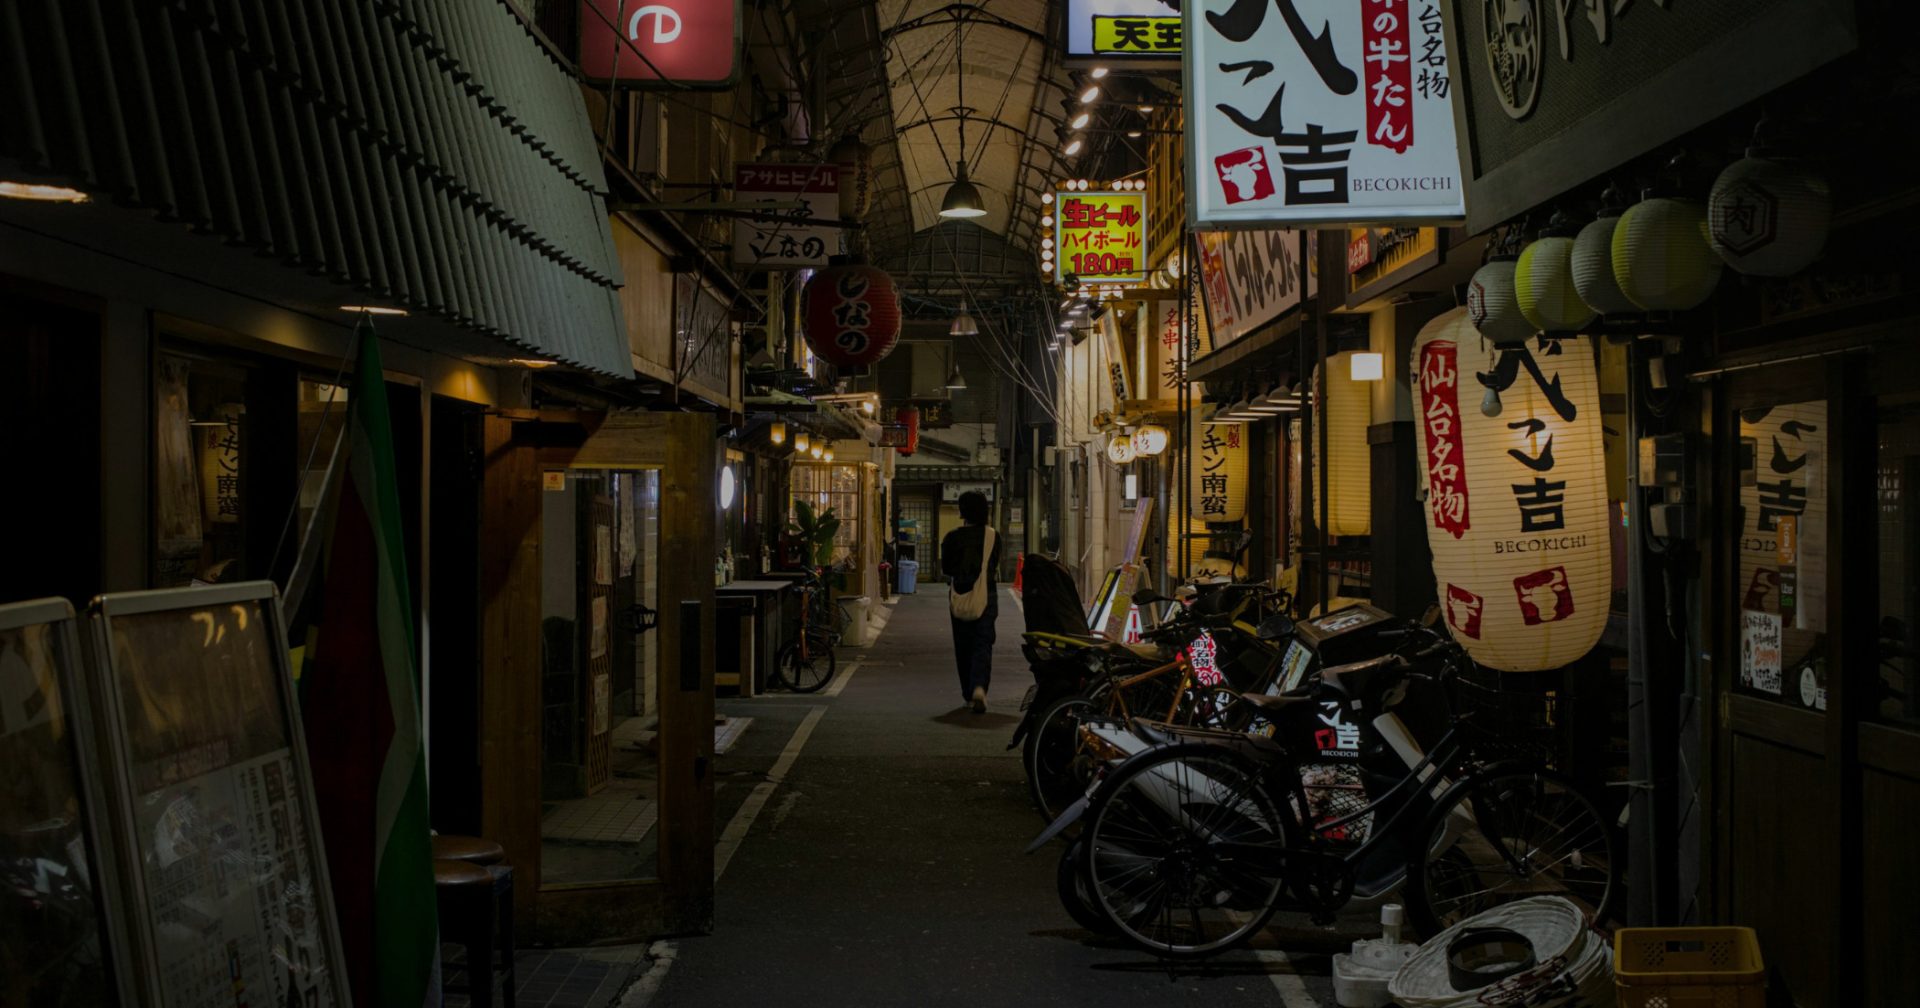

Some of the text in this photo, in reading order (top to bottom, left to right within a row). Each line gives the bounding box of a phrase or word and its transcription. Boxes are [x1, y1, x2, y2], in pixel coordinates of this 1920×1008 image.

[1417, 0, 1450, 99] 台名物
[1366, 0, 1409, 142] の牛たん
[1353, 177, 1452, 192] BECOKICHI
[1062, 199, 1140, 228] 生ビール
[1723, 195, 1756, 235] 肉
[1062, 230, 1141, 250] ハイボール
[1071, 252, 1133, 276] 180円
[1421, 353, 1465, 524] 仙台名物
[1495, 535, 1587, 554] BECOKICHI
